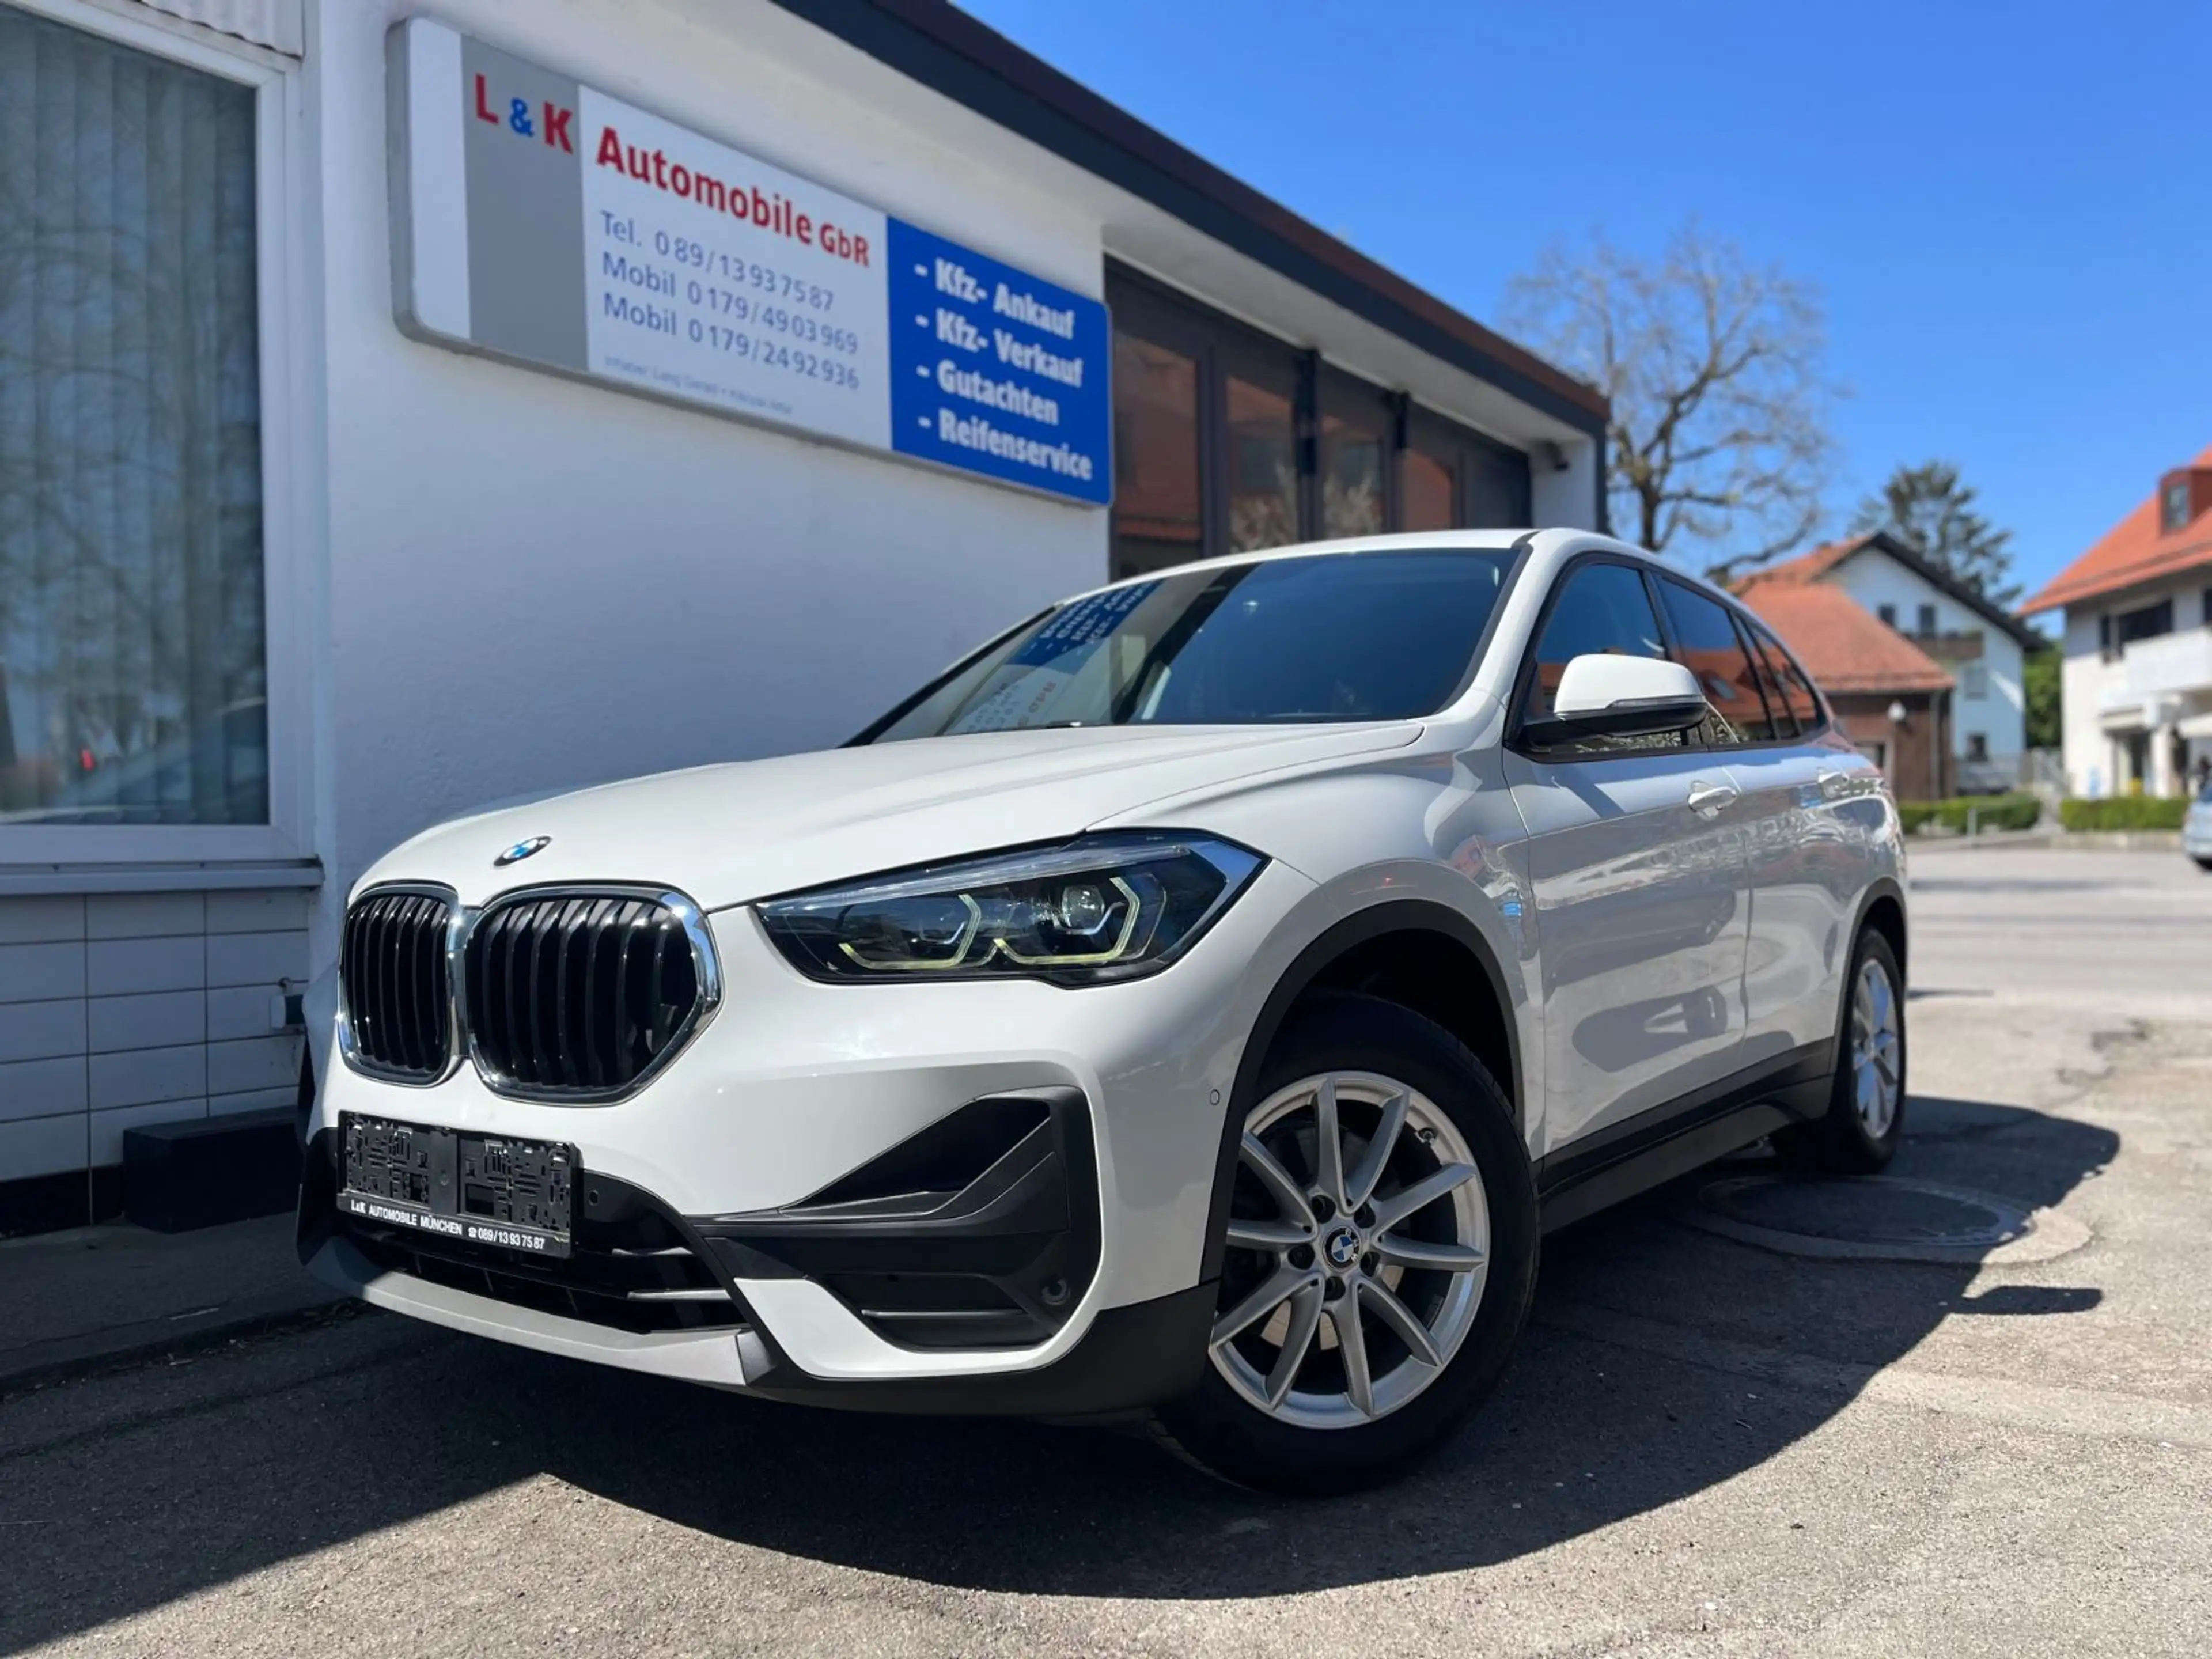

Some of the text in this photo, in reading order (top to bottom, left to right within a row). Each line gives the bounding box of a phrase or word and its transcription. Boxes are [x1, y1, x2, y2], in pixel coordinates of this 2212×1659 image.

[475, 72, 499, 125] L
[544, 100, 574, 156] K
[596, 126, 812, 245] Automobile
[819, 223, 869, 268] GbR
[600, 209, 642, 248] Tel.
[603, 250, 676, 298] Mobil
[935, 257, 988, 304] Kfz-
[993, 282, 1075, 340] Ankauf
[604, 291, 677, 339] Mobil
[935, 308, 989, 353] Kfz-
[993, 329, 1084, 389] Verkauf
[937, 359, 1059, 426] Gutachten
[938, 407, 1093, 481] Reifenservice
[369, 1204, 418, 1226] AUTOMOBILE
[420, 1215, 463, 1236] MÜNCHEN
